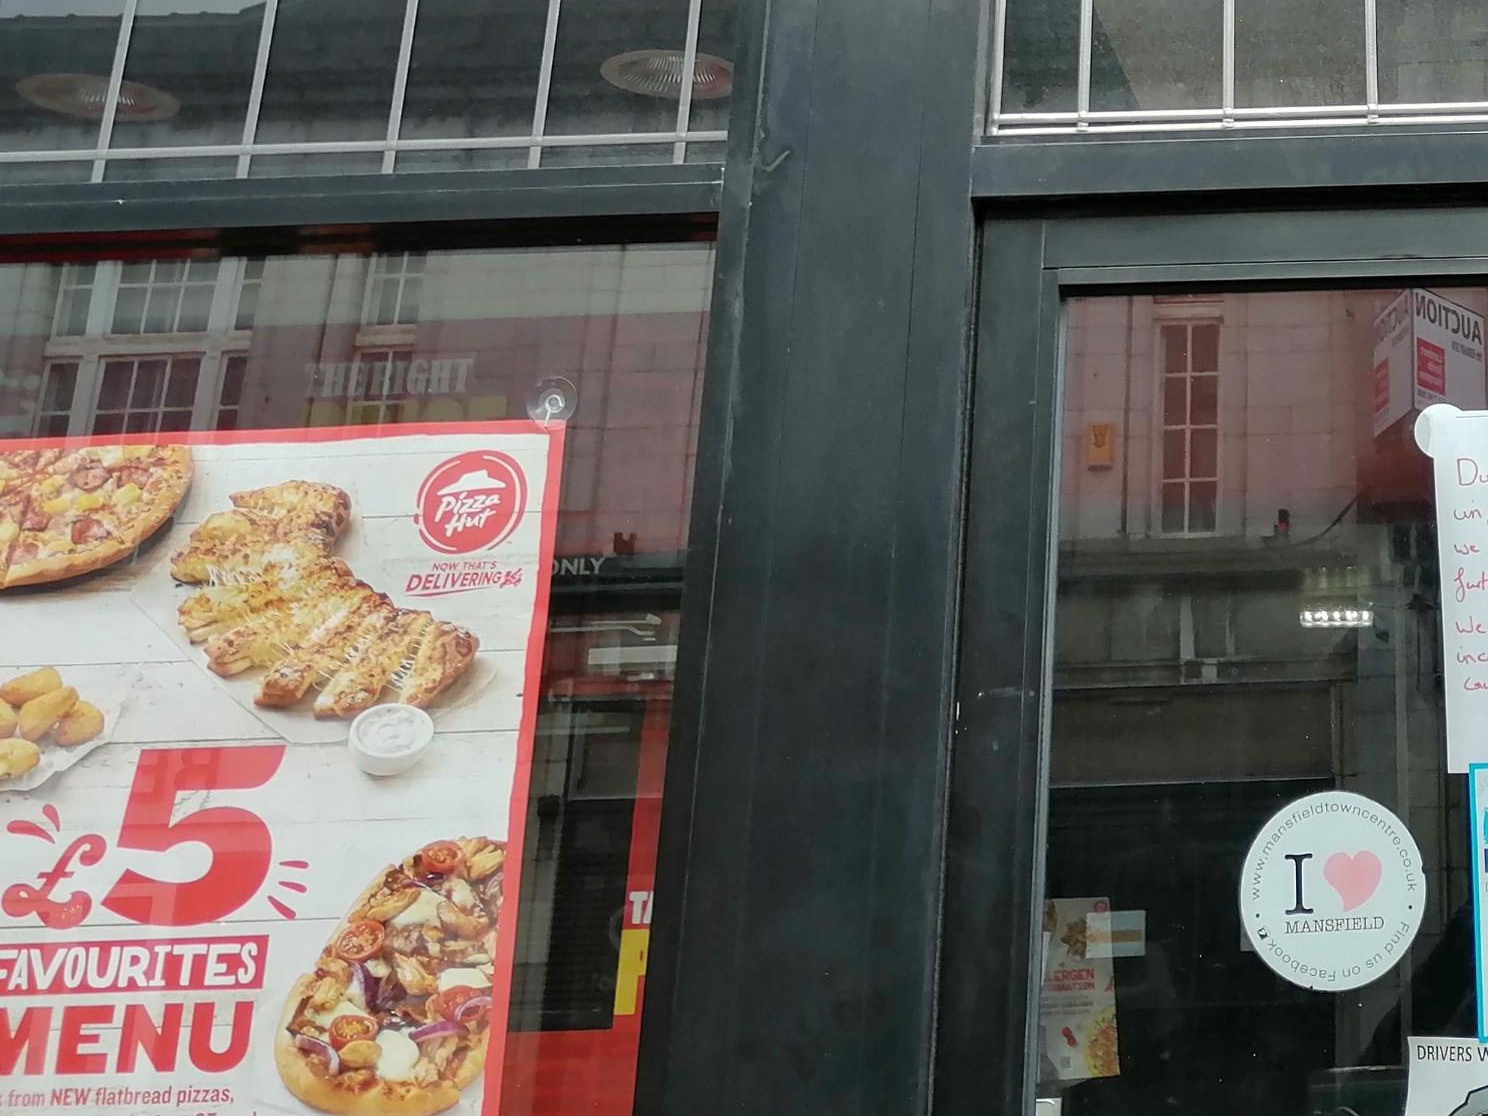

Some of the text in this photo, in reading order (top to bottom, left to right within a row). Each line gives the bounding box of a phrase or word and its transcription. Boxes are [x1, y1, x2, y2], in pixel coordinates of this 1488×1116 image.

[369, 358, 474, 395] RIGHT
[435, 492, 500, 522] Pizza
[445, 509, 497, 537] Hut
[432, 561, 497, 571] NOW THAT'S
[405, 570, 501, 592] DELIVERING
[1455, 616, 1485, 634] We
[1252, 802, 1417, 901] www.mansfieldtowncentre.co.uk
[1285, 853, 1313, 915] I
[1285, 916, 1384, 934] MANSFIELD
[1268, 922, 1409, 982] Find us on Facebook
[0, 1001, 254, 1076] MENU
[1417, 1045, 1472, 1061] DRIVERS
[8, 1086, 234, 1108] from NEW flatbread pizzas,
